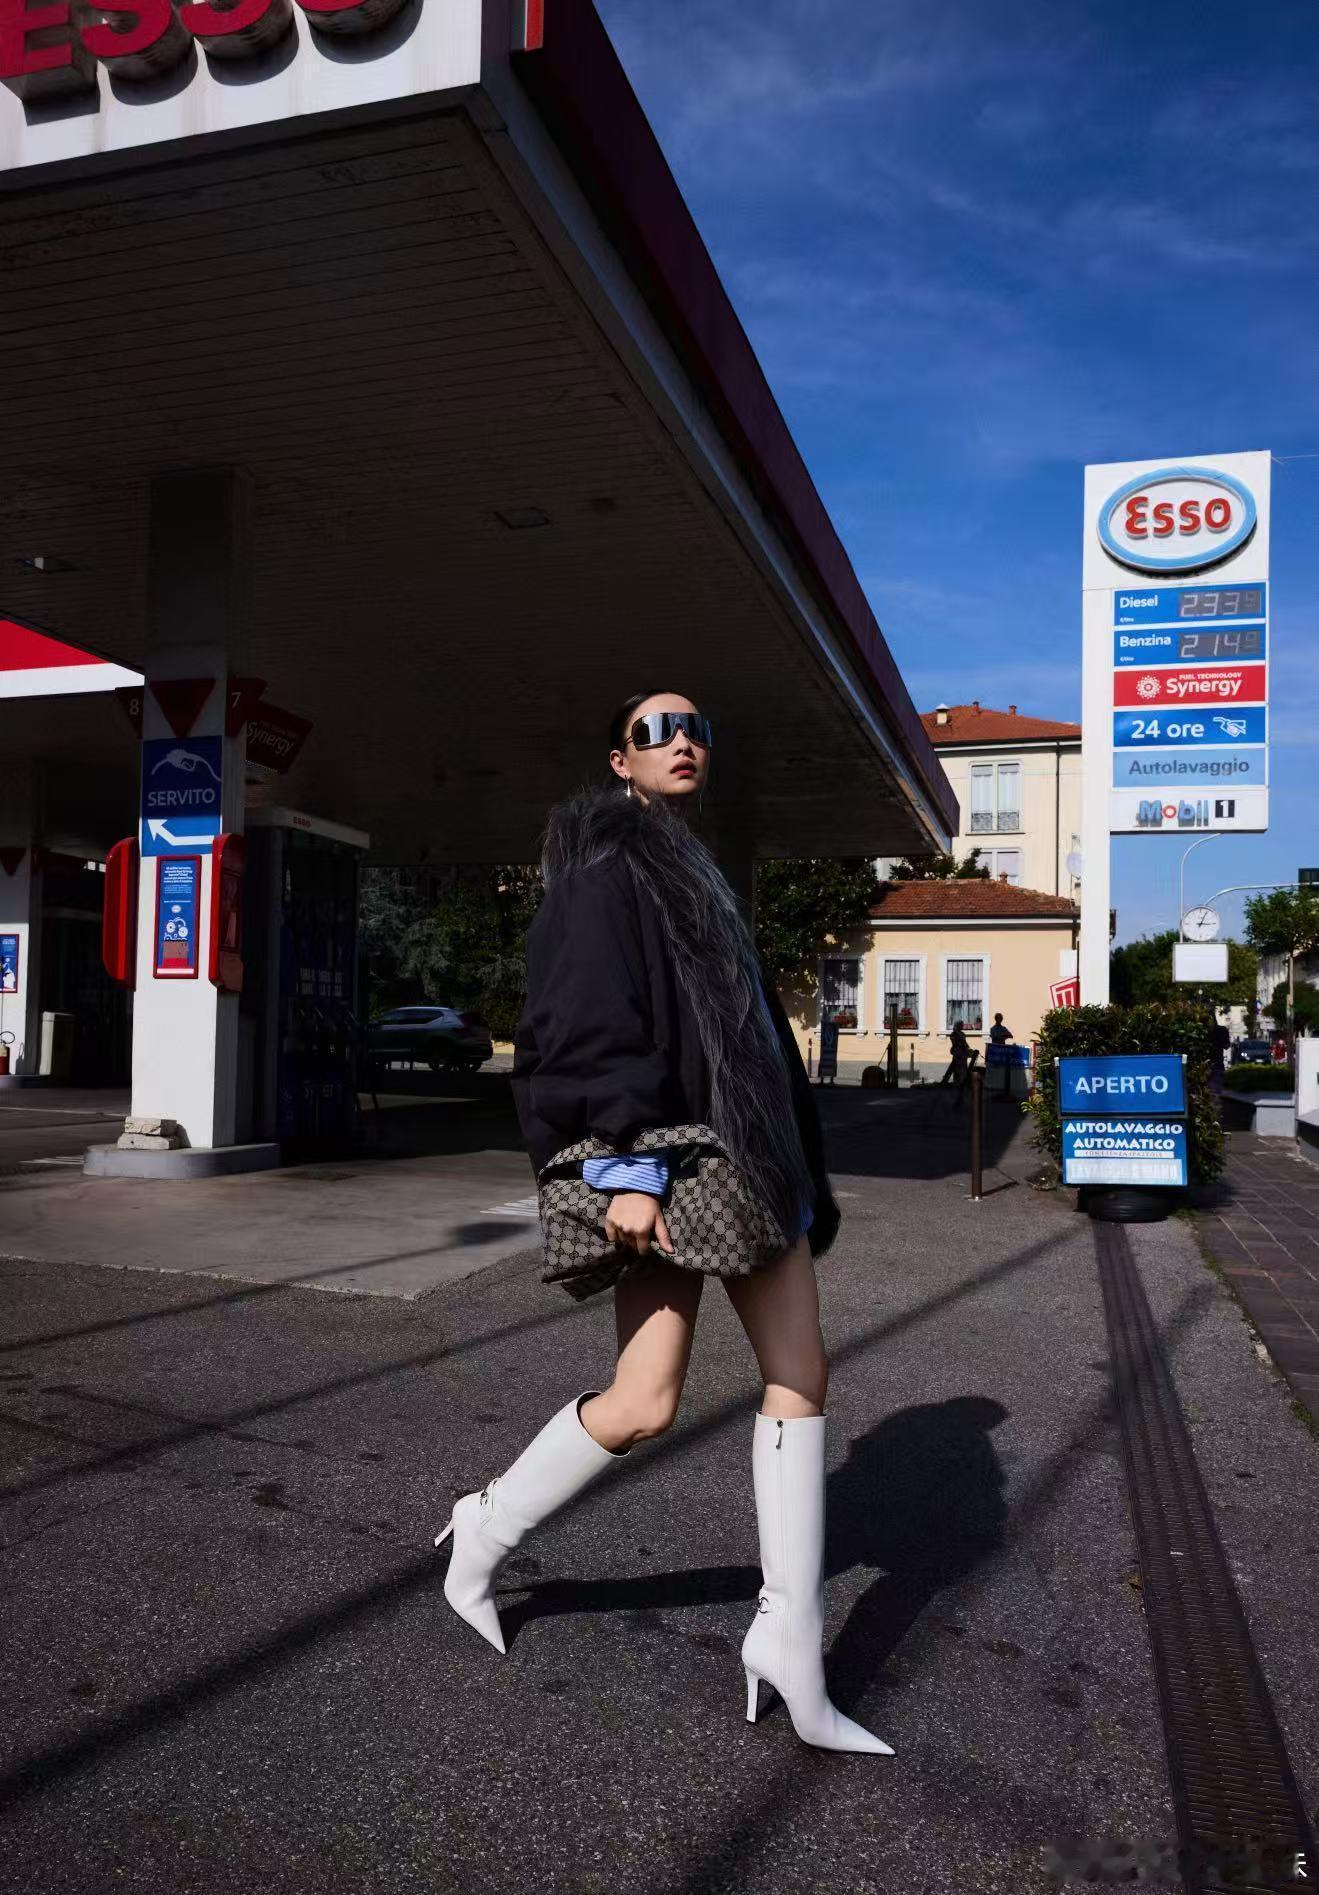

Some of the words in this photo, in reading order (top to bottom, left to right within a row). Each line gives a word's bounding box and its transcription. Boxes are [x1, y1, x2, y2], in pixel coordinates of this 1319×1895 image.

[1119, 595, 1158, 608] Diesel
[1119, 634, 1171, 647] Benzina
[1166, 679, 1242, 697] Synergy
[129, 698, 140, 716] 8
[231, 691, 241, 709] 7
[1131, 721, 1160, 738] 24
[1166, 723, 1204, 738] ore
[1128, 758, 1250, 777] Autolavaggio
[147, 788, 216, 807] SERVITO
[1138, 800, 1209, 823] Mobil
[1075, 1075, 1169, 1095] APERTO
[1065, 1122, 1183, 1135] AUTOLAVAGGIO
[1073, 1137, 1175, 1150] AUTOMATICO
